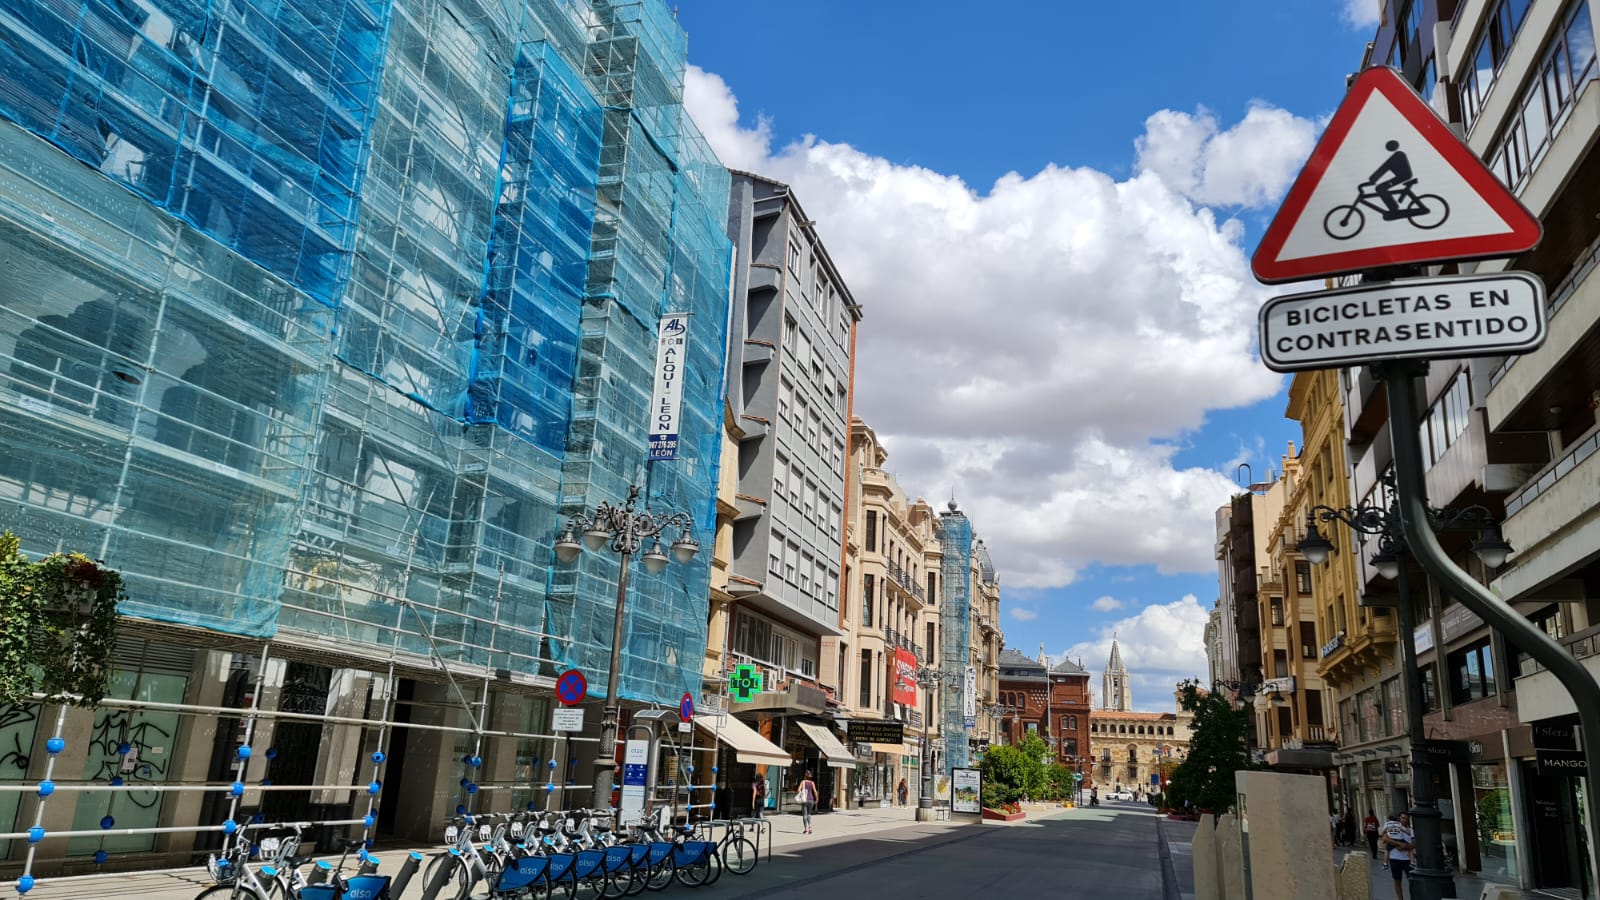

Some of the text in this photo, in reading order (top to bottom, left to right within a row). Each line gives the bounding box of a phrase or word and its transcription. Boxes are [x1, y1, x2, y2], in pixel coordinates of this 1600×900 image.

[1287, 289, 1510, 327] BICICLETAS EN
[1276, 315, 1528, 353] CONTRASENTIDO
[1544, 759, 1588, 768] MANGO
[579, 859, 595, 867] alsa
[519, 866, 537, 875] alsa
[350, 888, 371, 898] alsa
